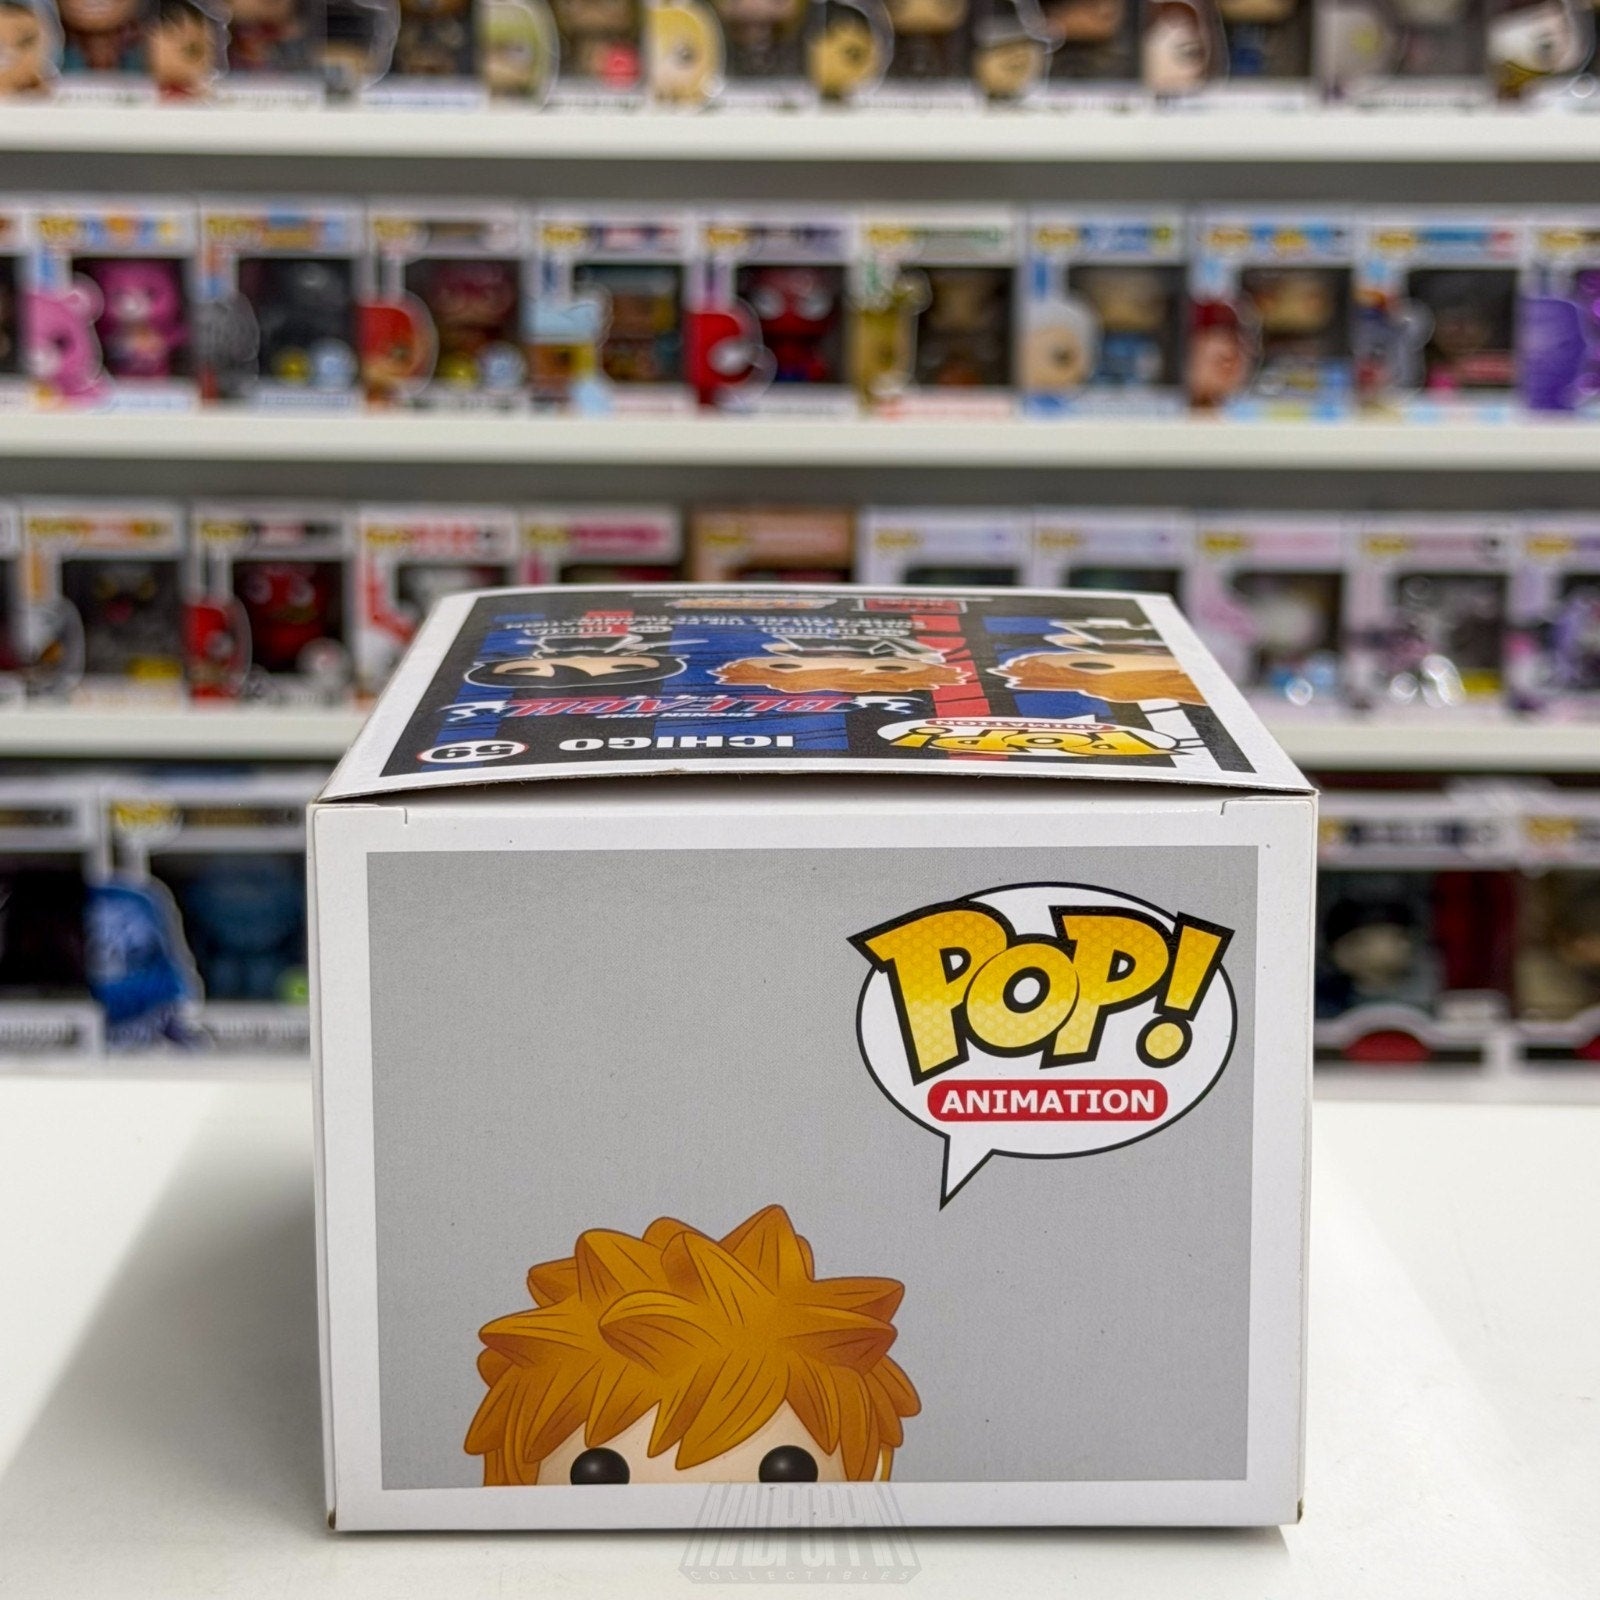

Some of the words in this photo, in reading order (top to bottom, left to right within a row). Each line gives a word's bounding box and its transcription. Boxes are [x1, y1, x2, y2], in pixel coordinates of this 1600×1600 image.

[505, 696, 853, 717] BLEACH
[935, 720, 1105, 731] ANIMATION
[430, 743, 514, 760] 59
[559, 735, 794, 751] ICHIGO
[890, 727, 1192, 757] POP!
[847, 900, 1235, 1086] POP!
[940, 1088, 1155, 1114] ANIMATION
